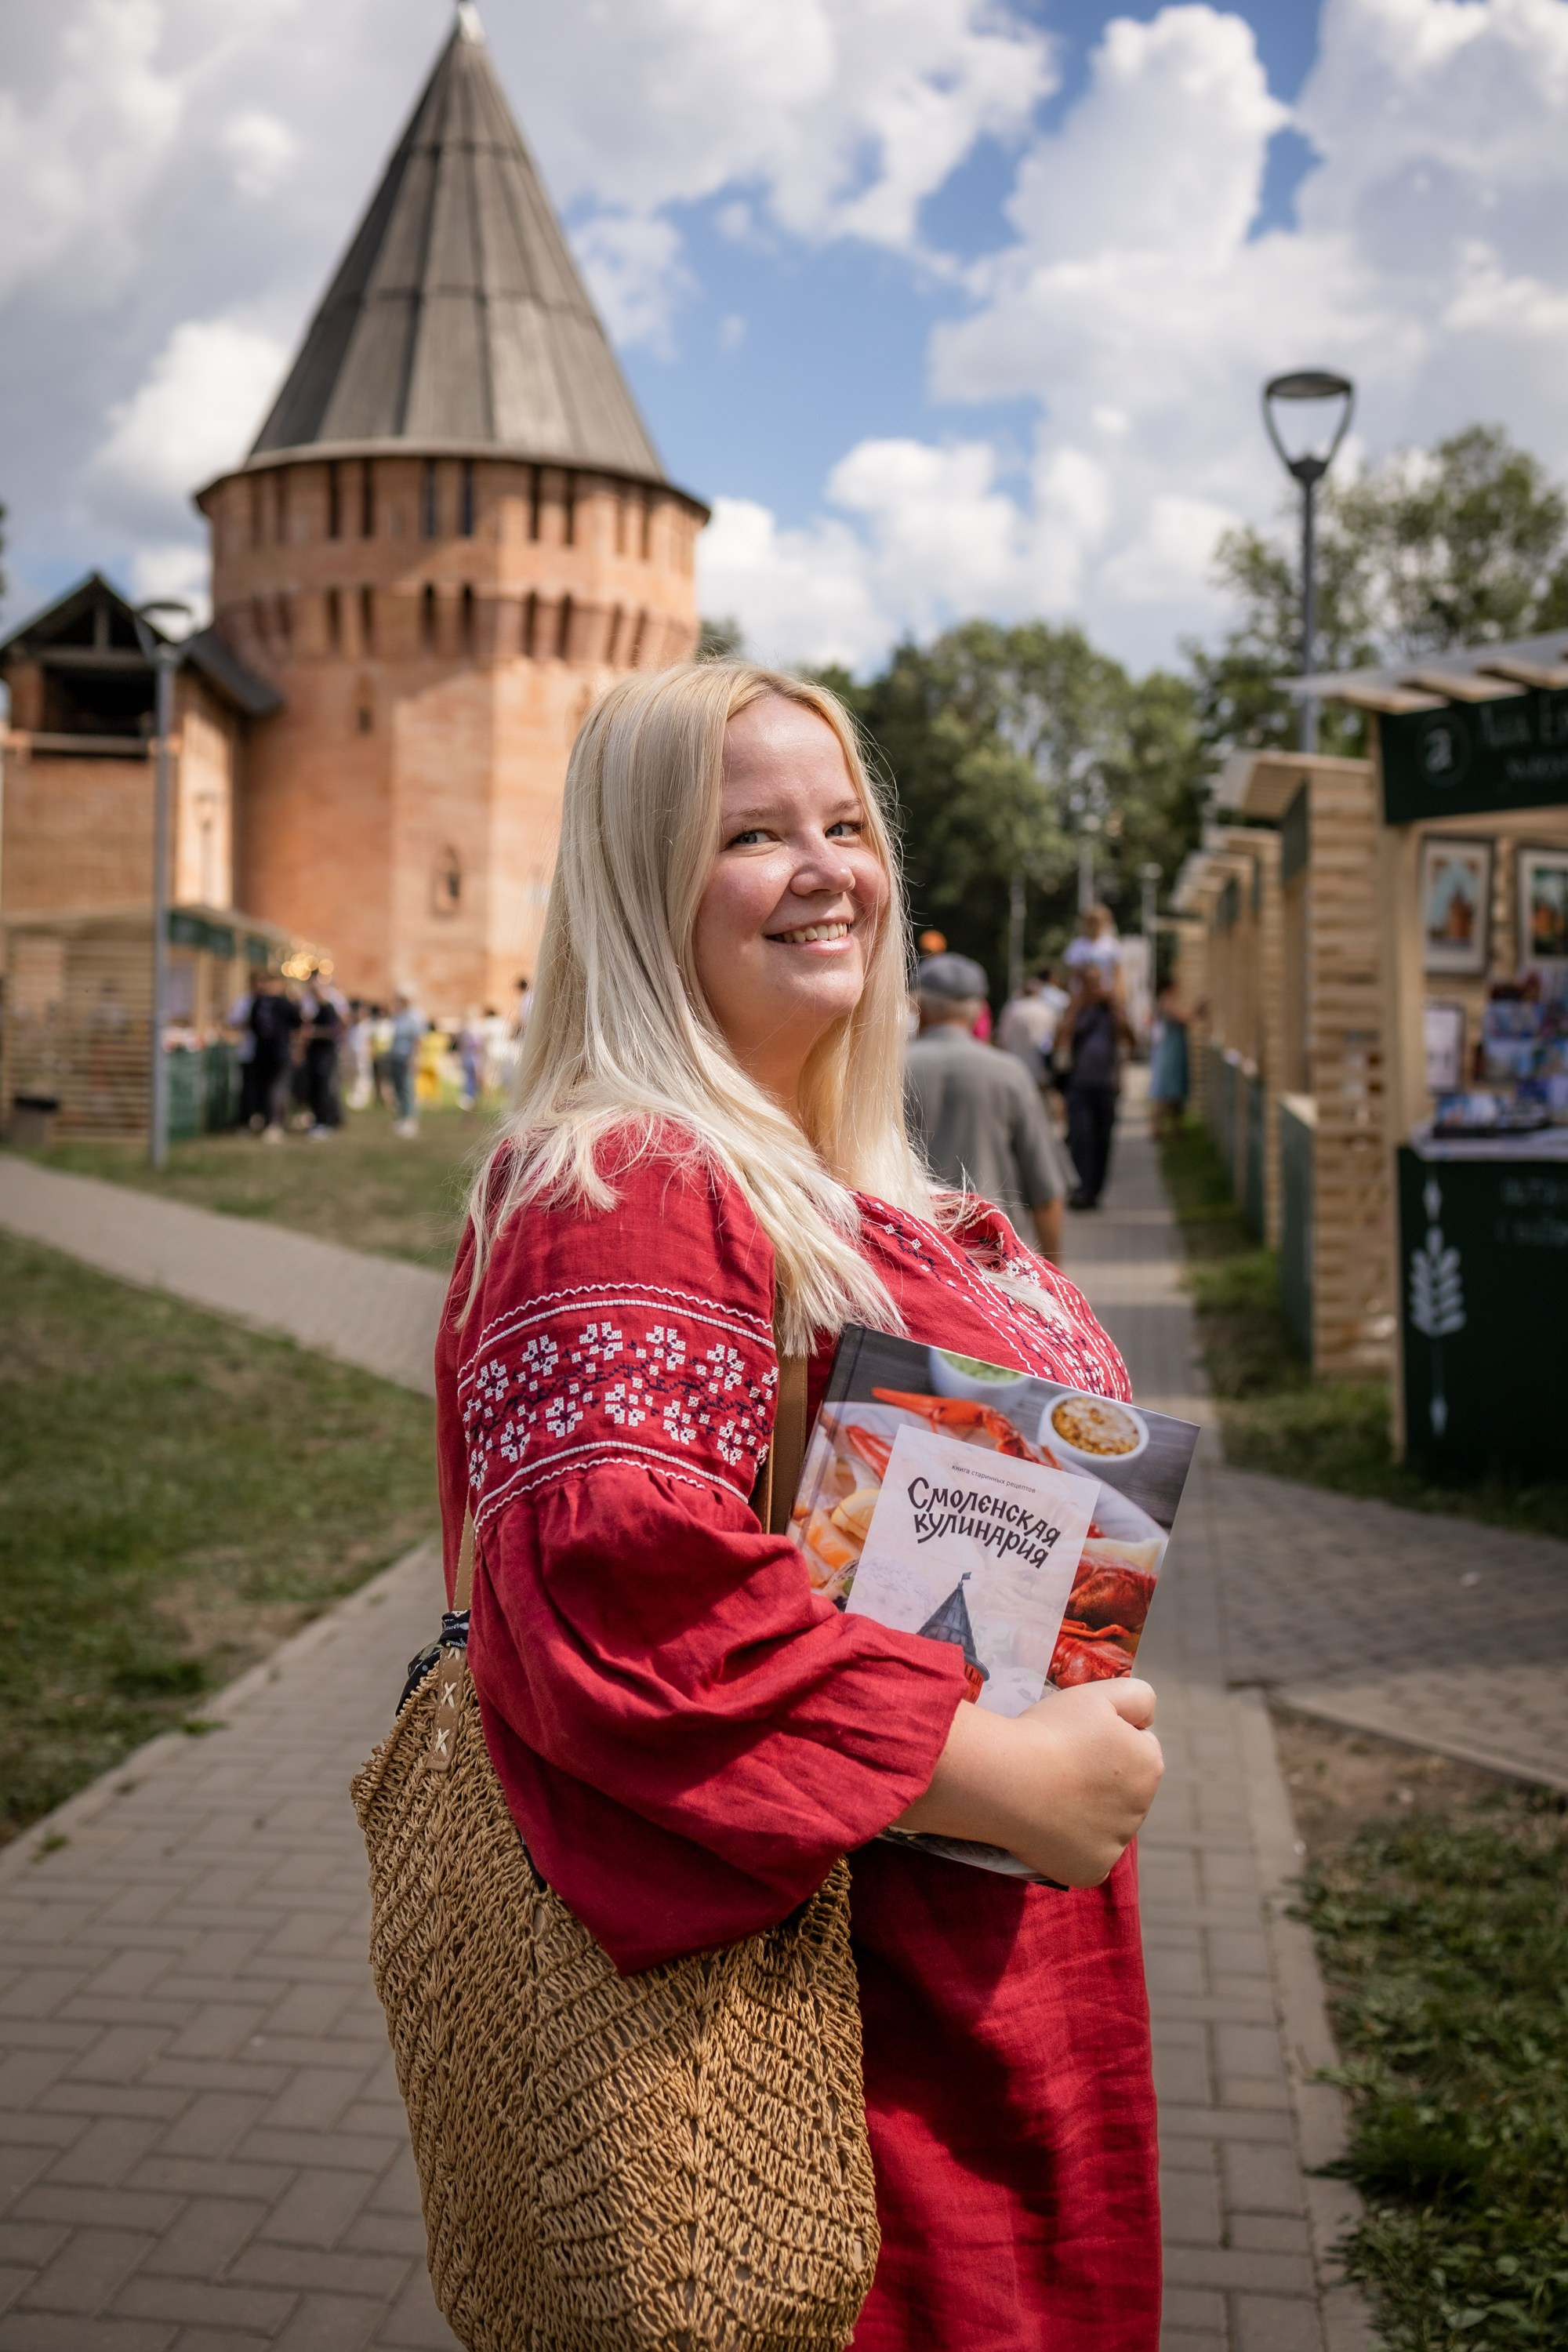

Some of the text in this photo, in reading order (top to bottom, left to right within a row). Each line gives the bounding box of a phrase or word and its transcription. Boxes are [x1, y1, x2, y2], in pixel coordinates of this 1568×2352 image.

[952, 1465, 1036, 1494] книга старинных рецептов
[908, 1477, 1061, 1548] Смоленская
[913, 1513, 1049, 1569] кулинария
